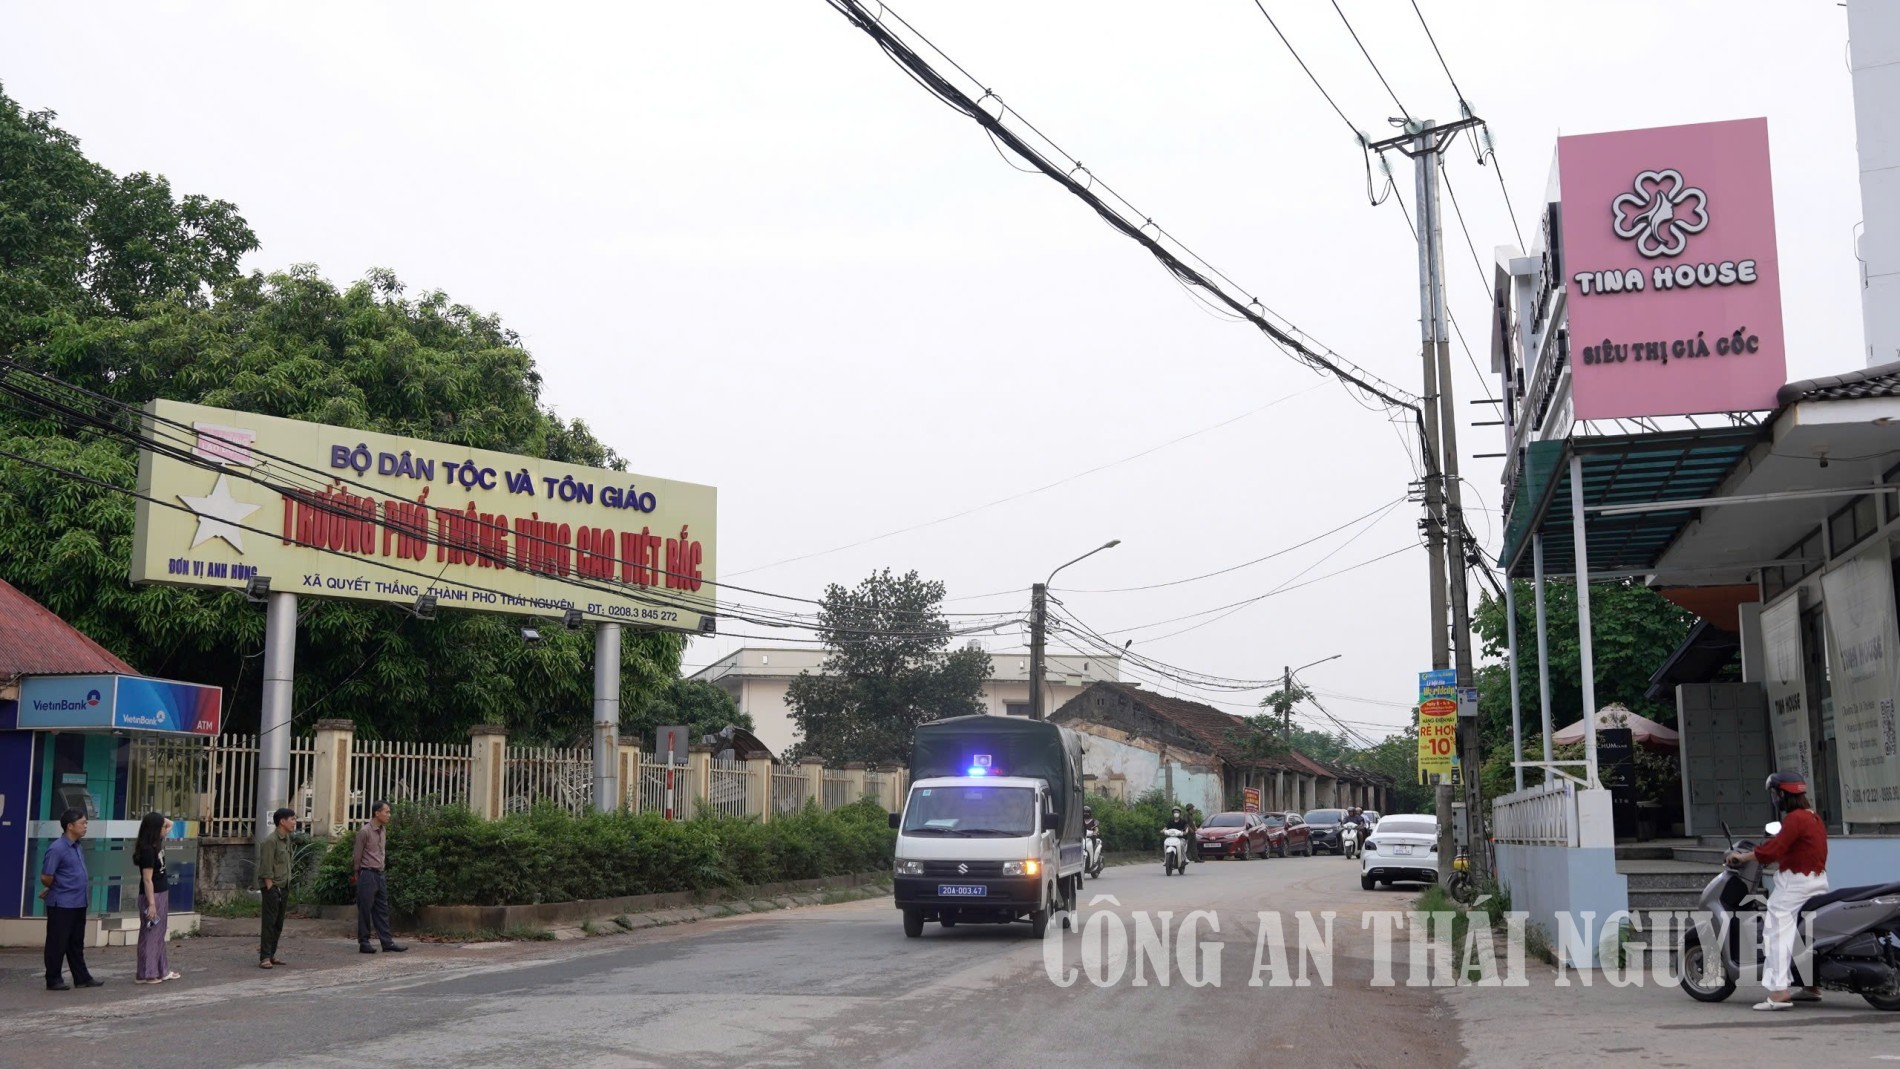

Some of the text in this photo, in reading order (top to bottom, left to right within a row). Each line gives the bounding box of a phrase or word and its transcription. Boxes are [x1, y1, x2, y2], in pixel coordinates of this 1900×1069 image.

[1574, 259, 1758, 296] TINA HOUSE
[1583, 326, 1760, 366] SIÊU THỊ GIÁ GỐC
[331, 443, 657, 514] BỘ DÂN TỘC VÀ TÔN GIÁO
[281, 478, 702, 591] TRƯỜNG PHỐ THÔNG VÙNG CAO VIỆT BẮC
[168, 557, 189, 576] ĐƠN
[193, 560, 204, 579] VỊ
[207, 562, 227, 579] ANH
[303, 573, 322, 588] XÃ
[327, 576, 371, 592] QUYẾT
[472, 589, 497, 604] PHỐ
[588, 603, 605, 616] ĐT:
[608, 605, 639, 618] 0208.3
[641, 610, 659, 620] 845
[661, 611, 678, 622] 272
[33, 700, 87, 711] VietinBank
[123, 714, 213, 731] VietinBank ATM
[1420, 723, 1431, 736] RẺ
[942, 887, 982, 895] 20A-003.47
